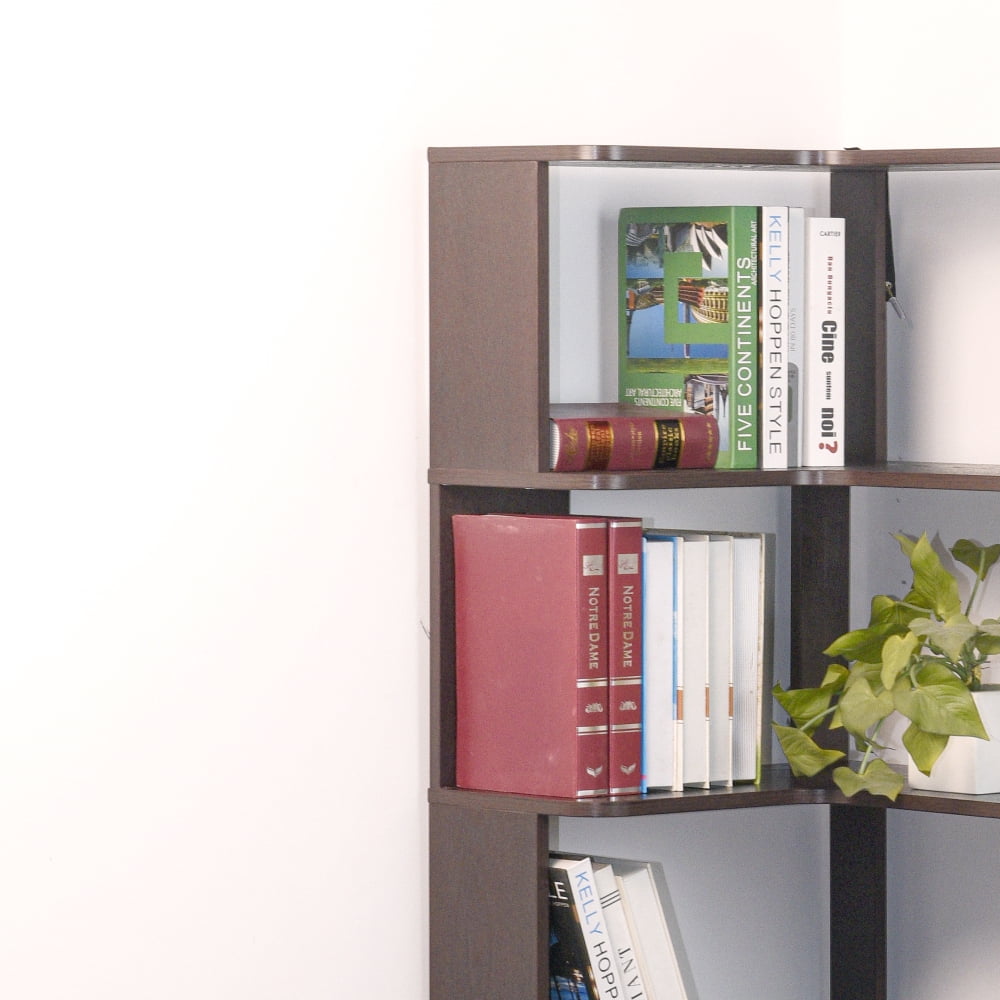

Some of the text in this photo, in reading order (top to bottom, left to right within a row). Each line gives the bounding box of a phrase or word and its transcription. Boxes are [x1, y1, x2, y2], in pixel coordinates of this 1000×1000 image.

[736, 256, 752, 450] FIVE CONTINENTS
[768, 215, 782, 454] KELLY HOPPEN STYLE
[821, 320, 838, 364] Cine
[589, 587, 600, 669] NOTRE DAME
[622, 586, 634, 668] NOTRE DAME
[576, 871, 602, 935] KELLY
